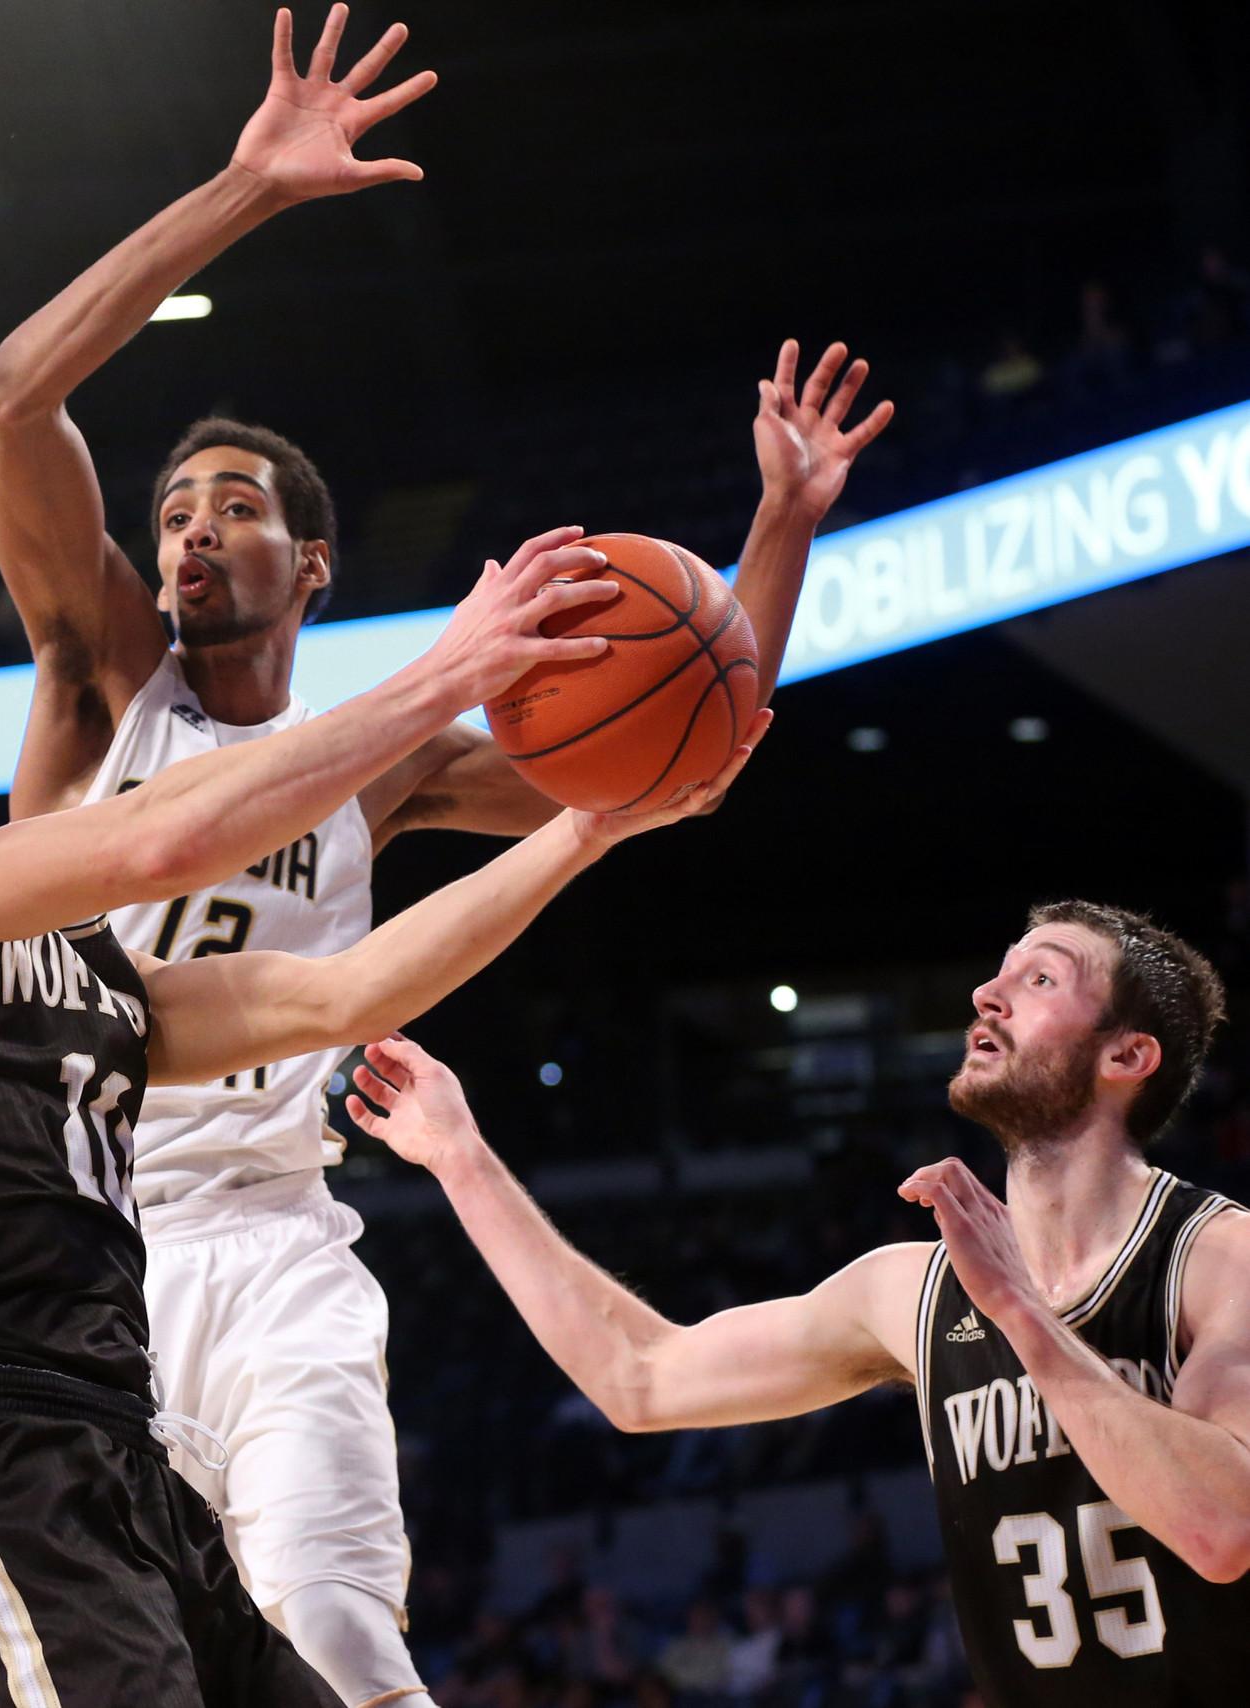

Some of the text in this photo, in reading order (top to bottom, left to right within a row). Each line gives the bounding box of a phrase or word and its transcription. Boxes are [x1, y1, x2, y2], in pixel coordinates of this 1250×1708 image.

[790, 455, 1169, 661] OBILIZING
[151, 895, 256, 962] 12
[945, 1329, 986, 1342] adidas
[943, 1357, 1163, 1486] WOFRD
[991, 1499, 1167, 1669] 35
